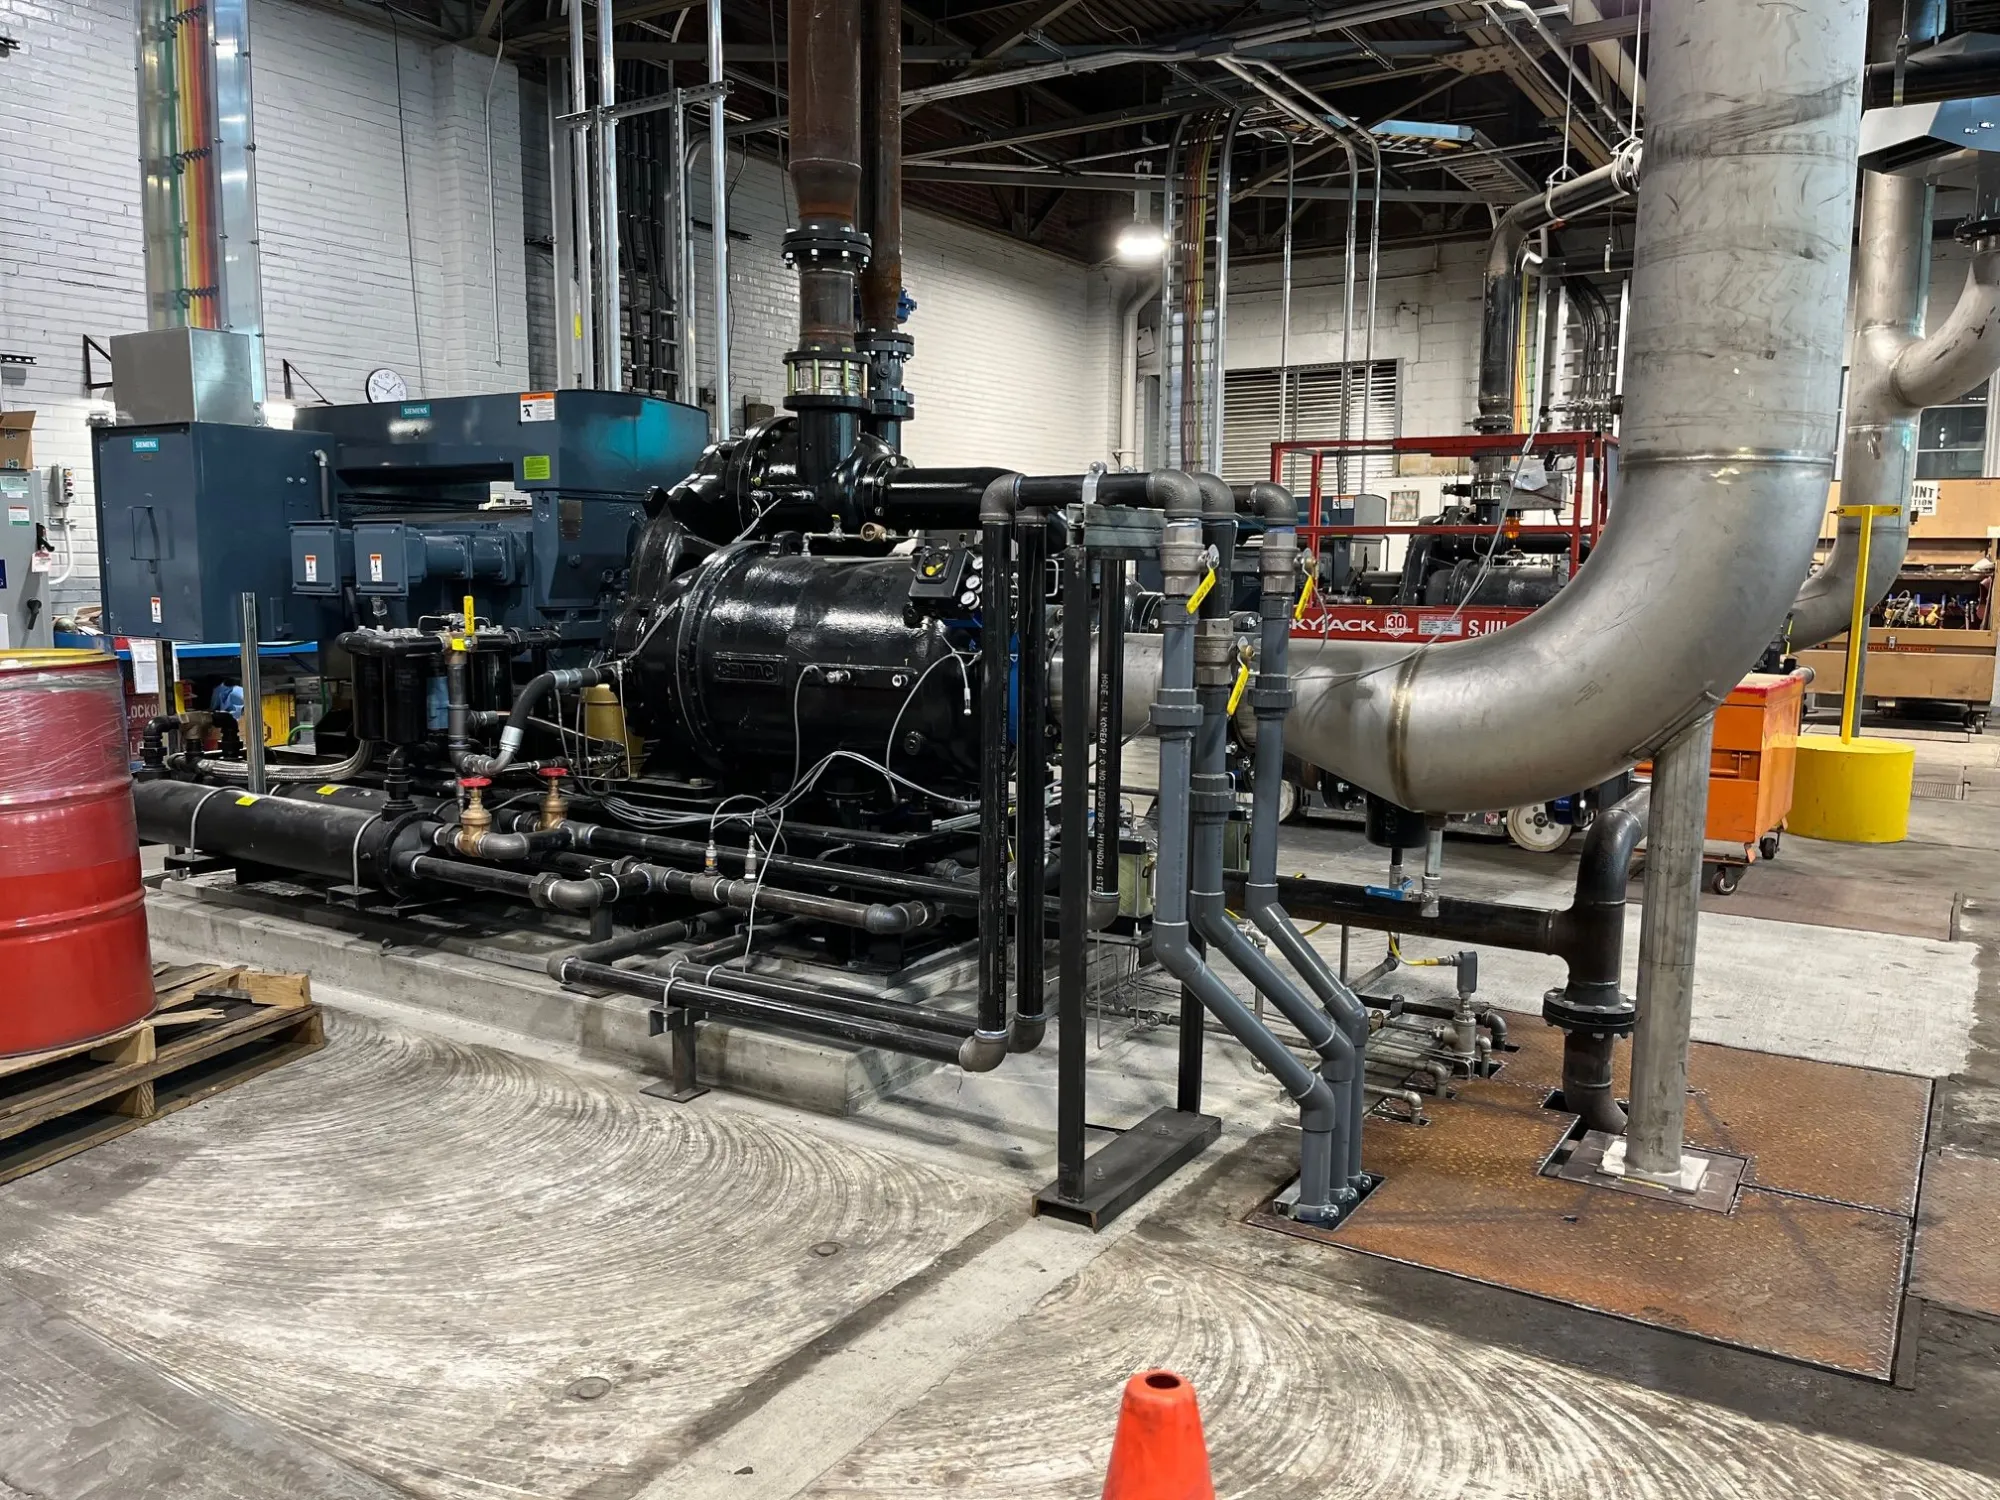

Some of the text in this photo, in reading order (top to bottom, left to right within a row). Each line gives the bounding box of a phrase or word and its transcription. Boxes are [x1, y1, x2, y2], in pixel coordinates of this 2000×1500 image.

[404, 407, 428, 415] SIEMENS
[135, 440, 157, 449] SIEMENS
[1911, 485, 1934, 499] INT
[1387, 615, 1404, 629] 30
[1099, 717, 1108, 744] KOREA
[1095, 832, 1105, 870] HYUNDAI
[1095, 875, 1104, 894] STE
